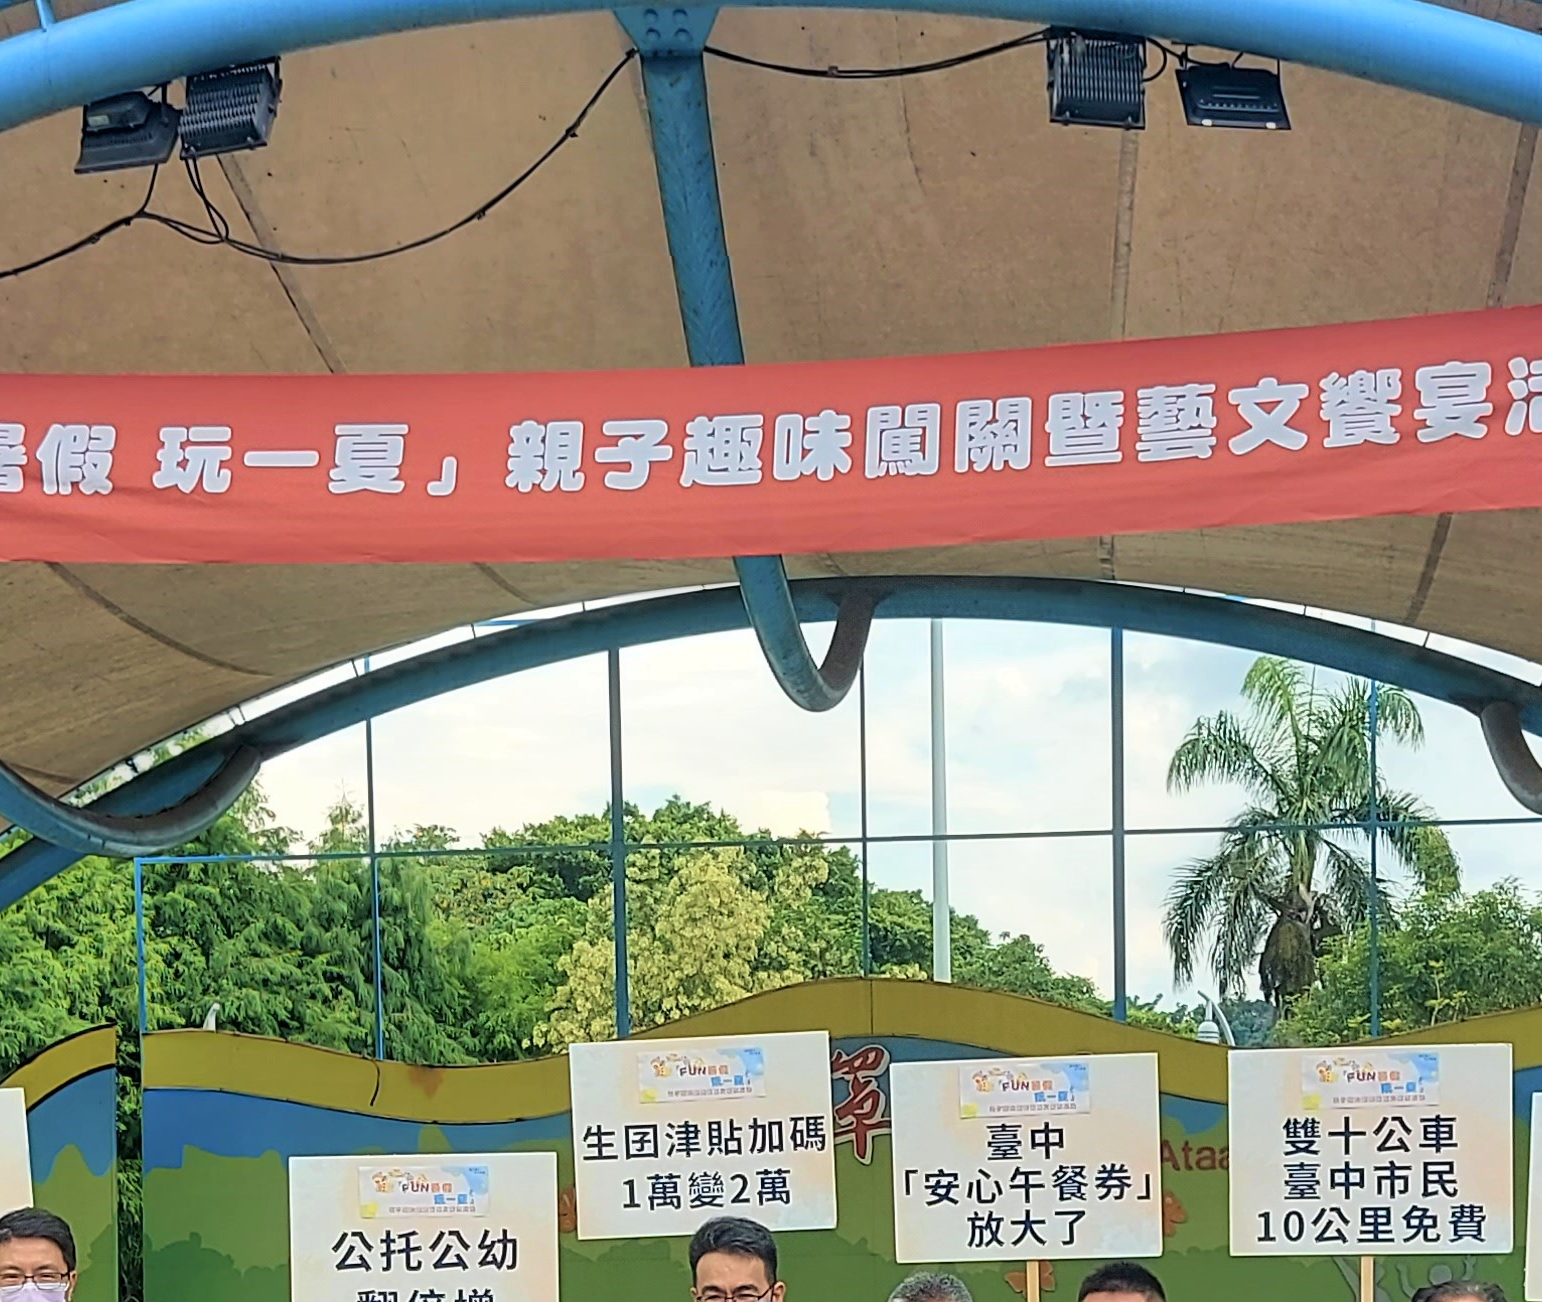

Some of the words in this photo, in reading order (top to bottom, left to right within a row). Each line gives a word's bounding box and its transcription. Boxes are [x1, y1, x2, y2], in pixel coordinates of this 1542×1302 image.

[985, 1121, 1066, 1162] 臺中
[1282, 1113, 1460, 1158] 雙十公車
[622, 1167, 793, 1212] 1萬變2萬
[904, 1163, 1152, 1208] 「安心午餐券」
[1282, 1158, 1460, 1202] 臺中市民
[966, 1208, 1088, 1250] 放大了
[1256, 1201, 1488, 1246] 10公里免費
[331, 1227, 520, 1274] 公托公幼
